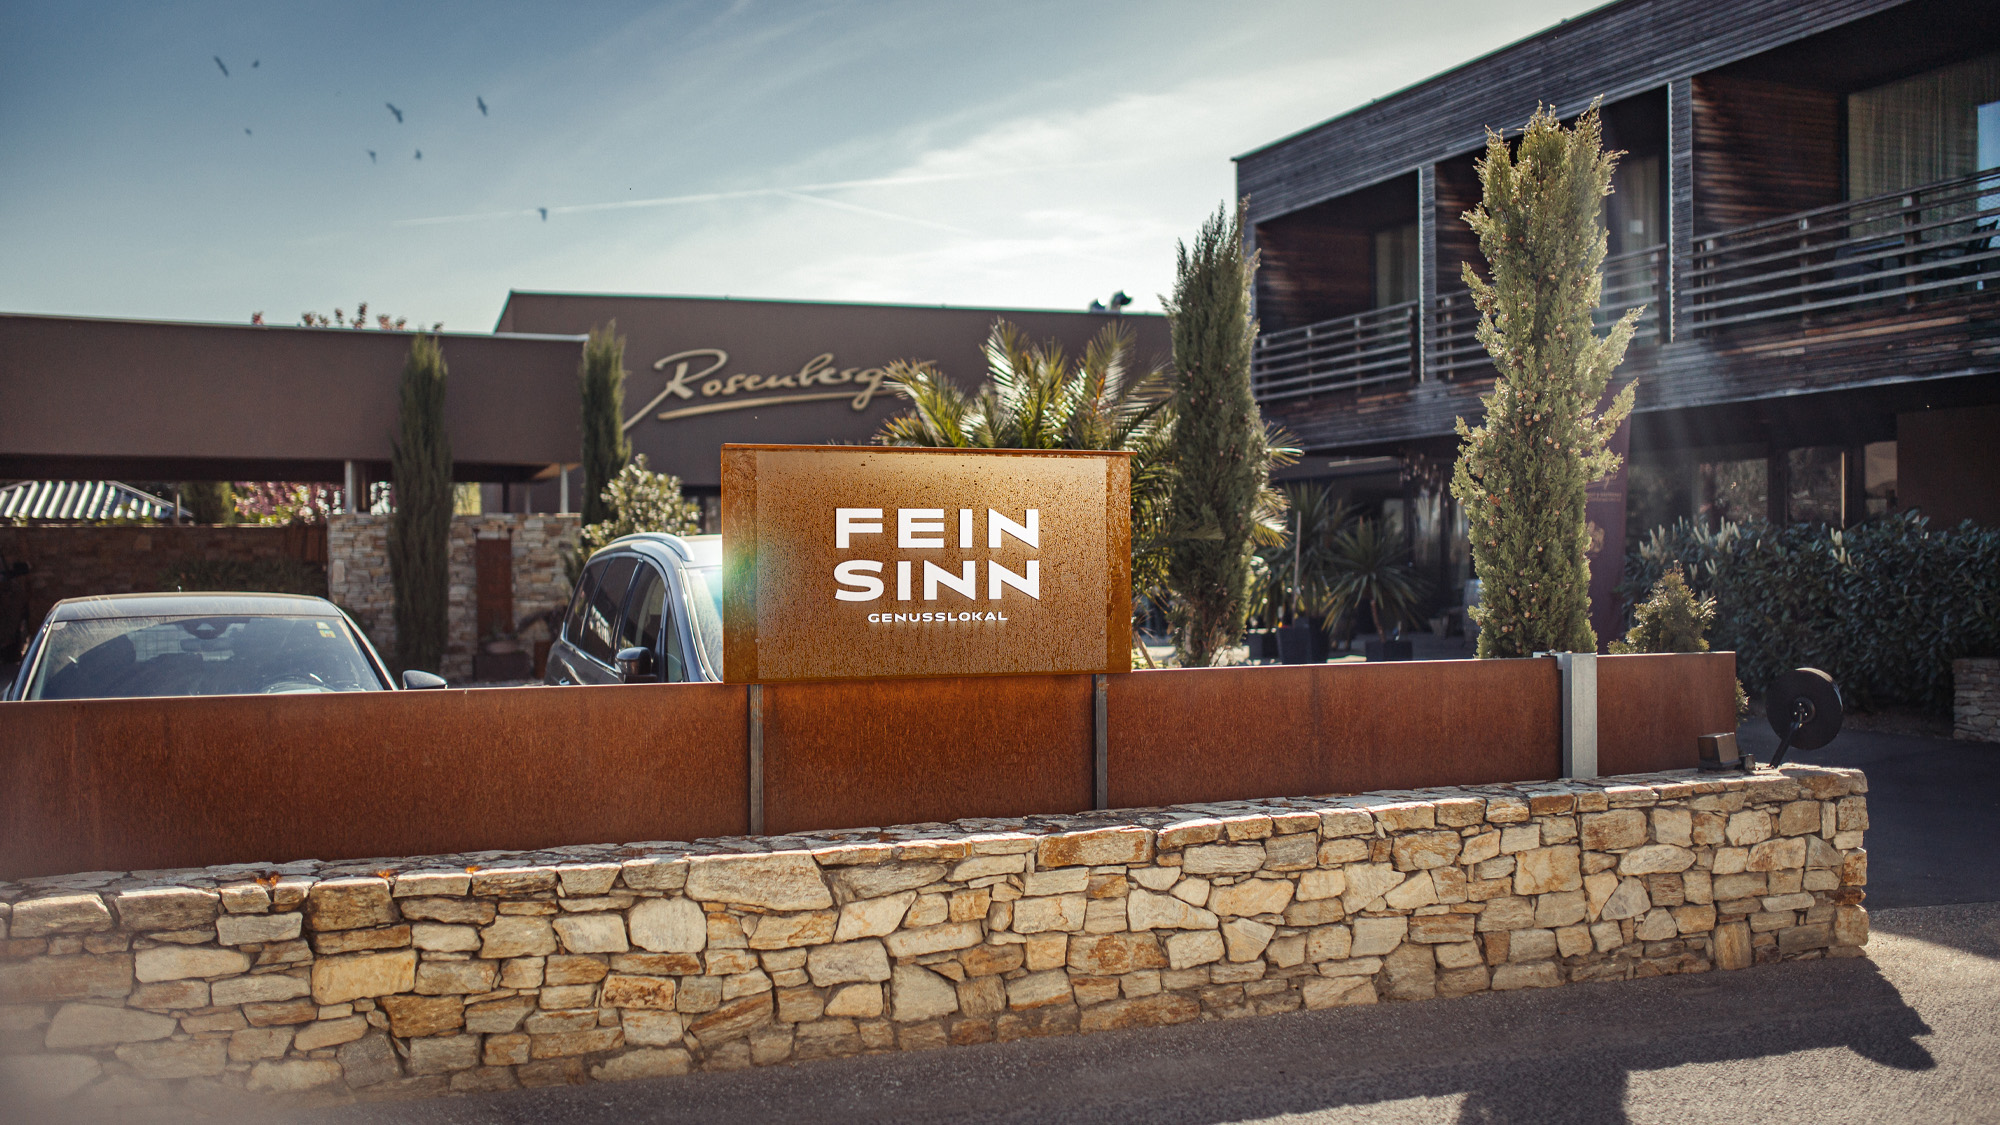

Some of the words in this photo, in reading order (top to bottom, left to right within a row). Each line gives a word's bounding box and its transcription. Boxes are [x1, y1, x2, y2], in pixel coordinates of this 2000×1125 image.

[622, 348, 937, 431] Rosenberg
[835, 508, 1039, 549] FEIN
[833, 559, 1040, 602] SINN
[867, 611, 1008, 623] GENUSSLOKAL
